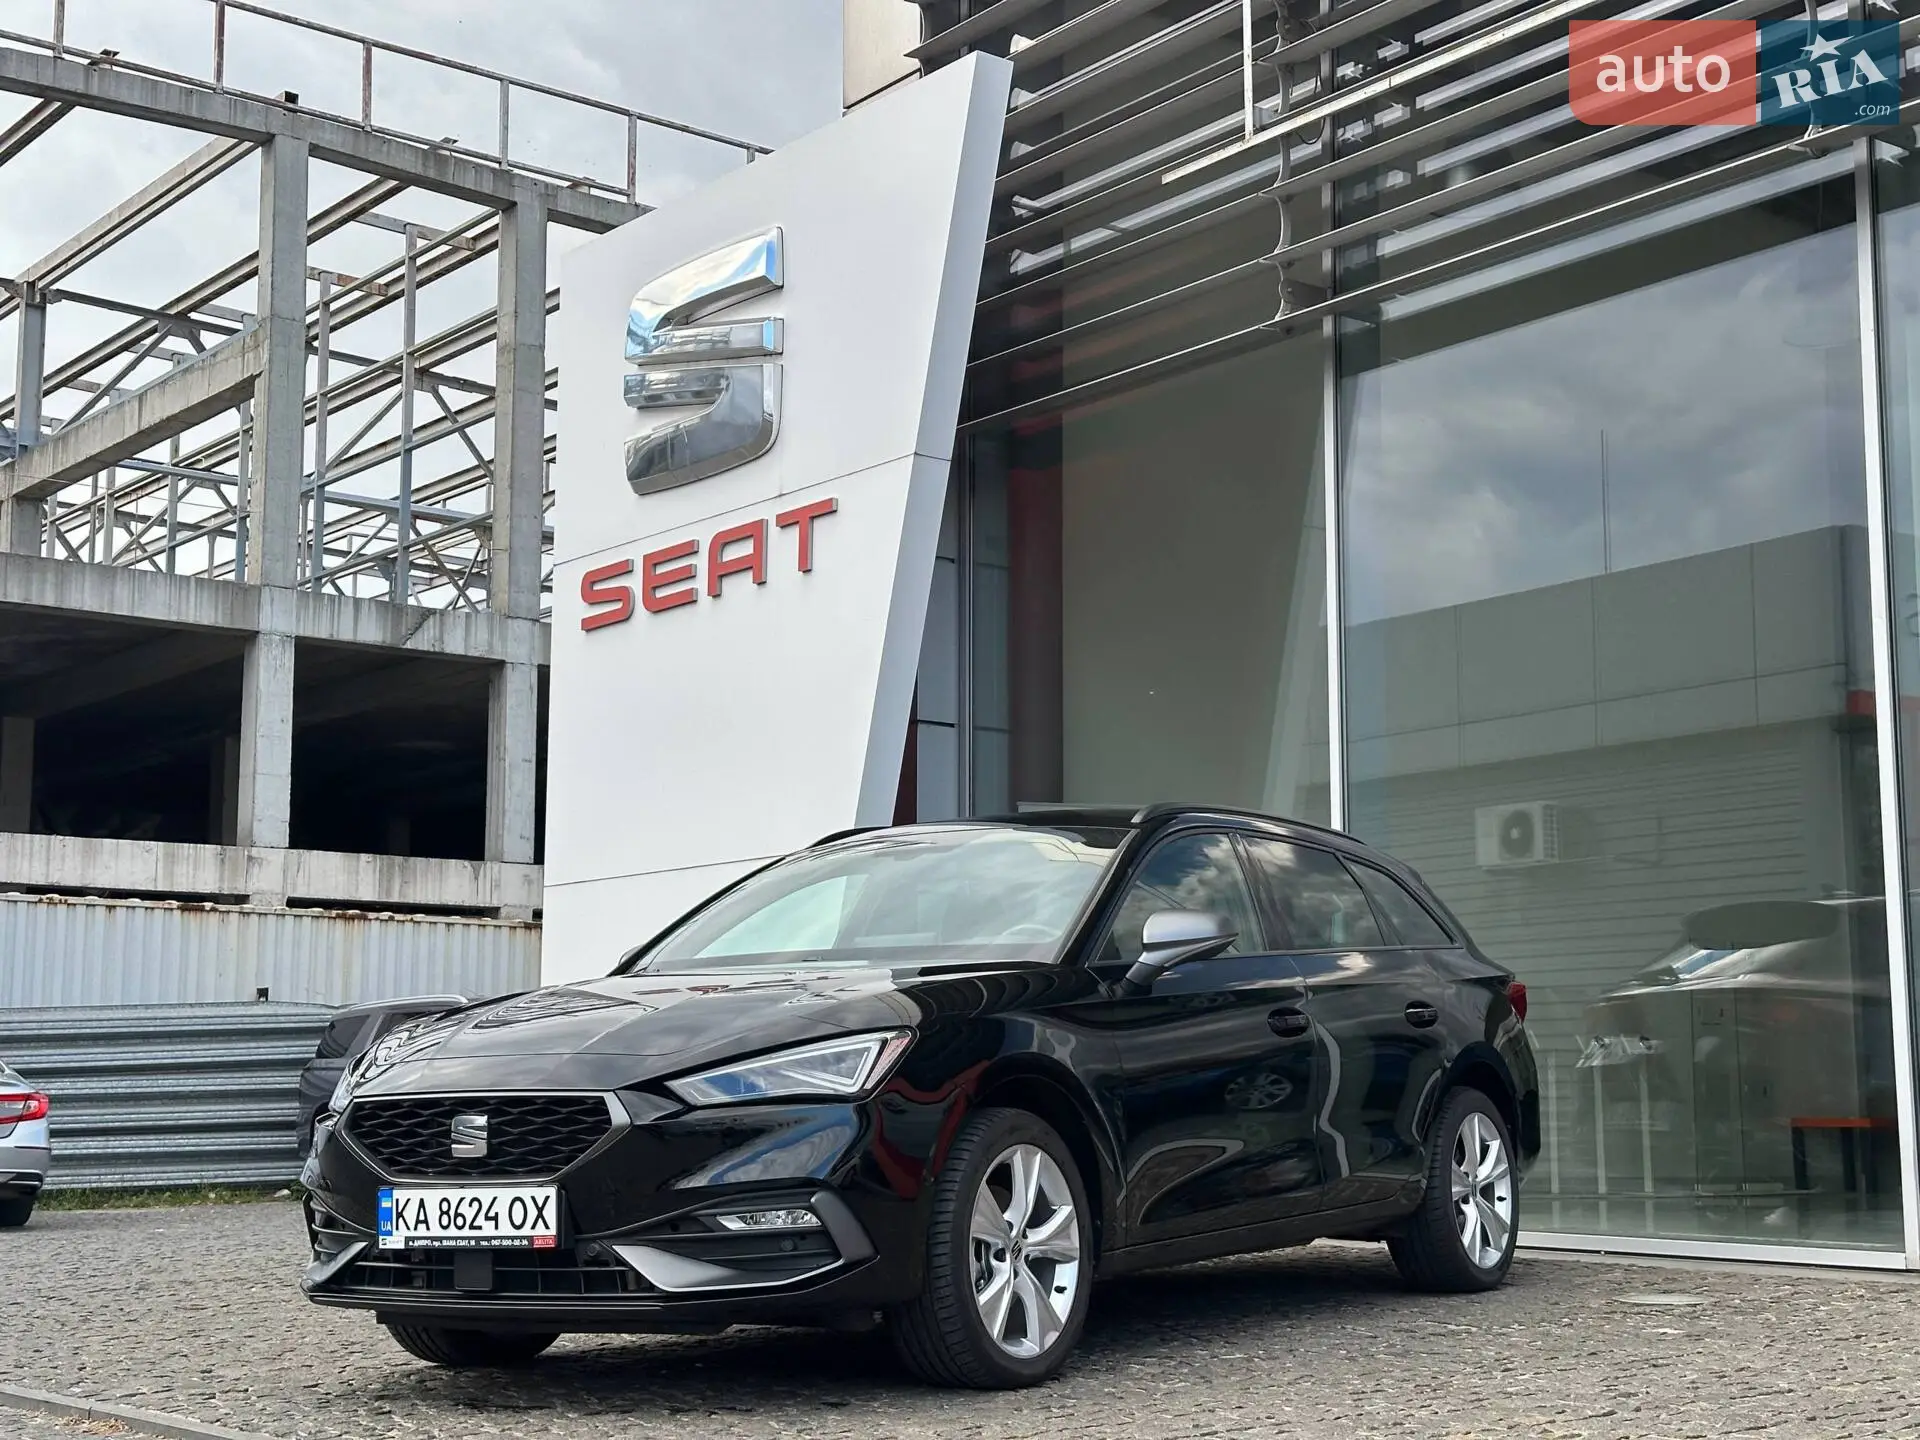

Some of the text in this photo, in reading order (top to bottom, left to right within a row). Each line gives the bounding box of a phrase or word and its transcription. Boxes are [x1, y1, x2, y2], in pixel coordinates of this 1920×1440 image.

[581, 497, 838, 632] SEAT
[381, 1220, 392, 1231] UA
[395, 1195, 551, 1231] KA 8624 OX
